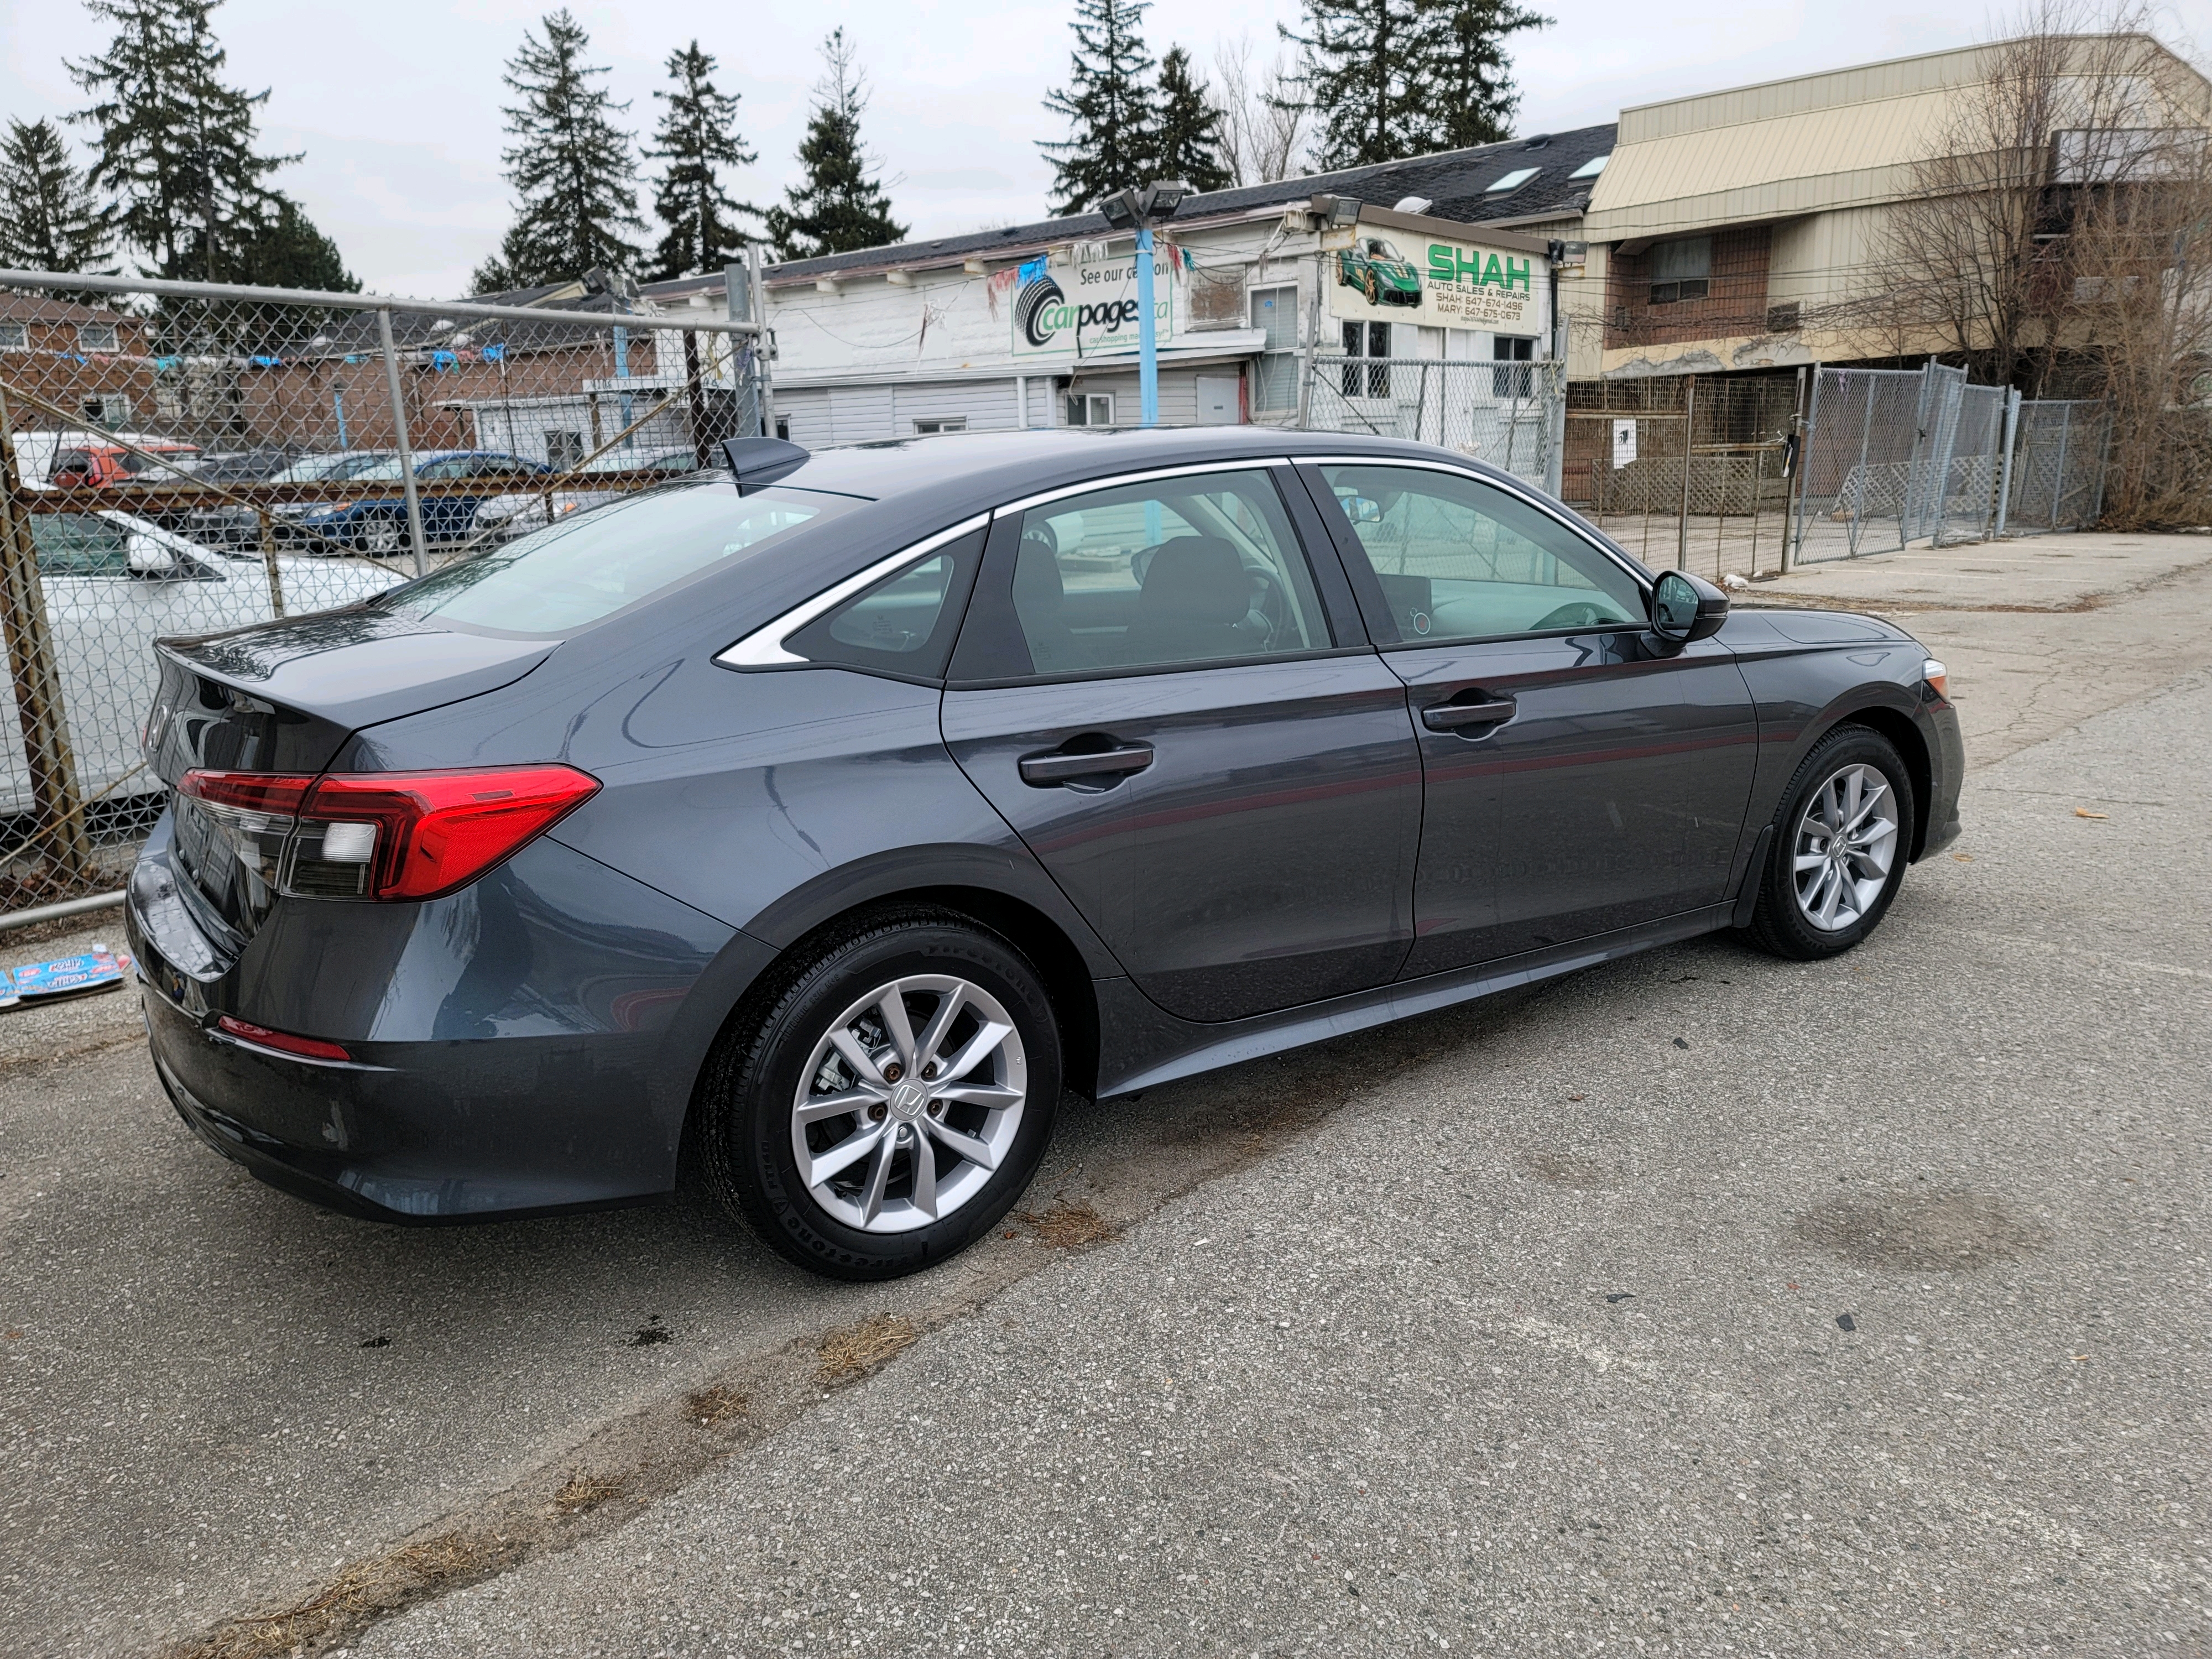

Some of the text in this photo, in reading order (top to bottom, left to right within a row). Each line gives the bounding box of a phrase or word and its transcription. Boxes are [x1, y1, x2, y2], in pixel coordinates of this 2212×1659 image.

[1081, 268, 1100, 285] See
[1104, 268, 1123, 282] our
[1154, 263, 1168, 276] on
[1428, 244, 1530, 292] SHAH
[1427, 281, 1453, 291] AUTO
[1456, 284, 1484, 295] SALES
[1496, 290, 1530, 301] REPAIRS
[1436, 293, 1522, 310] SHAH: 647-674-1496
[1438, 303, 1520, 321] MARY: 647-675-0673
[1100, 333, 1126, 343] shopping
